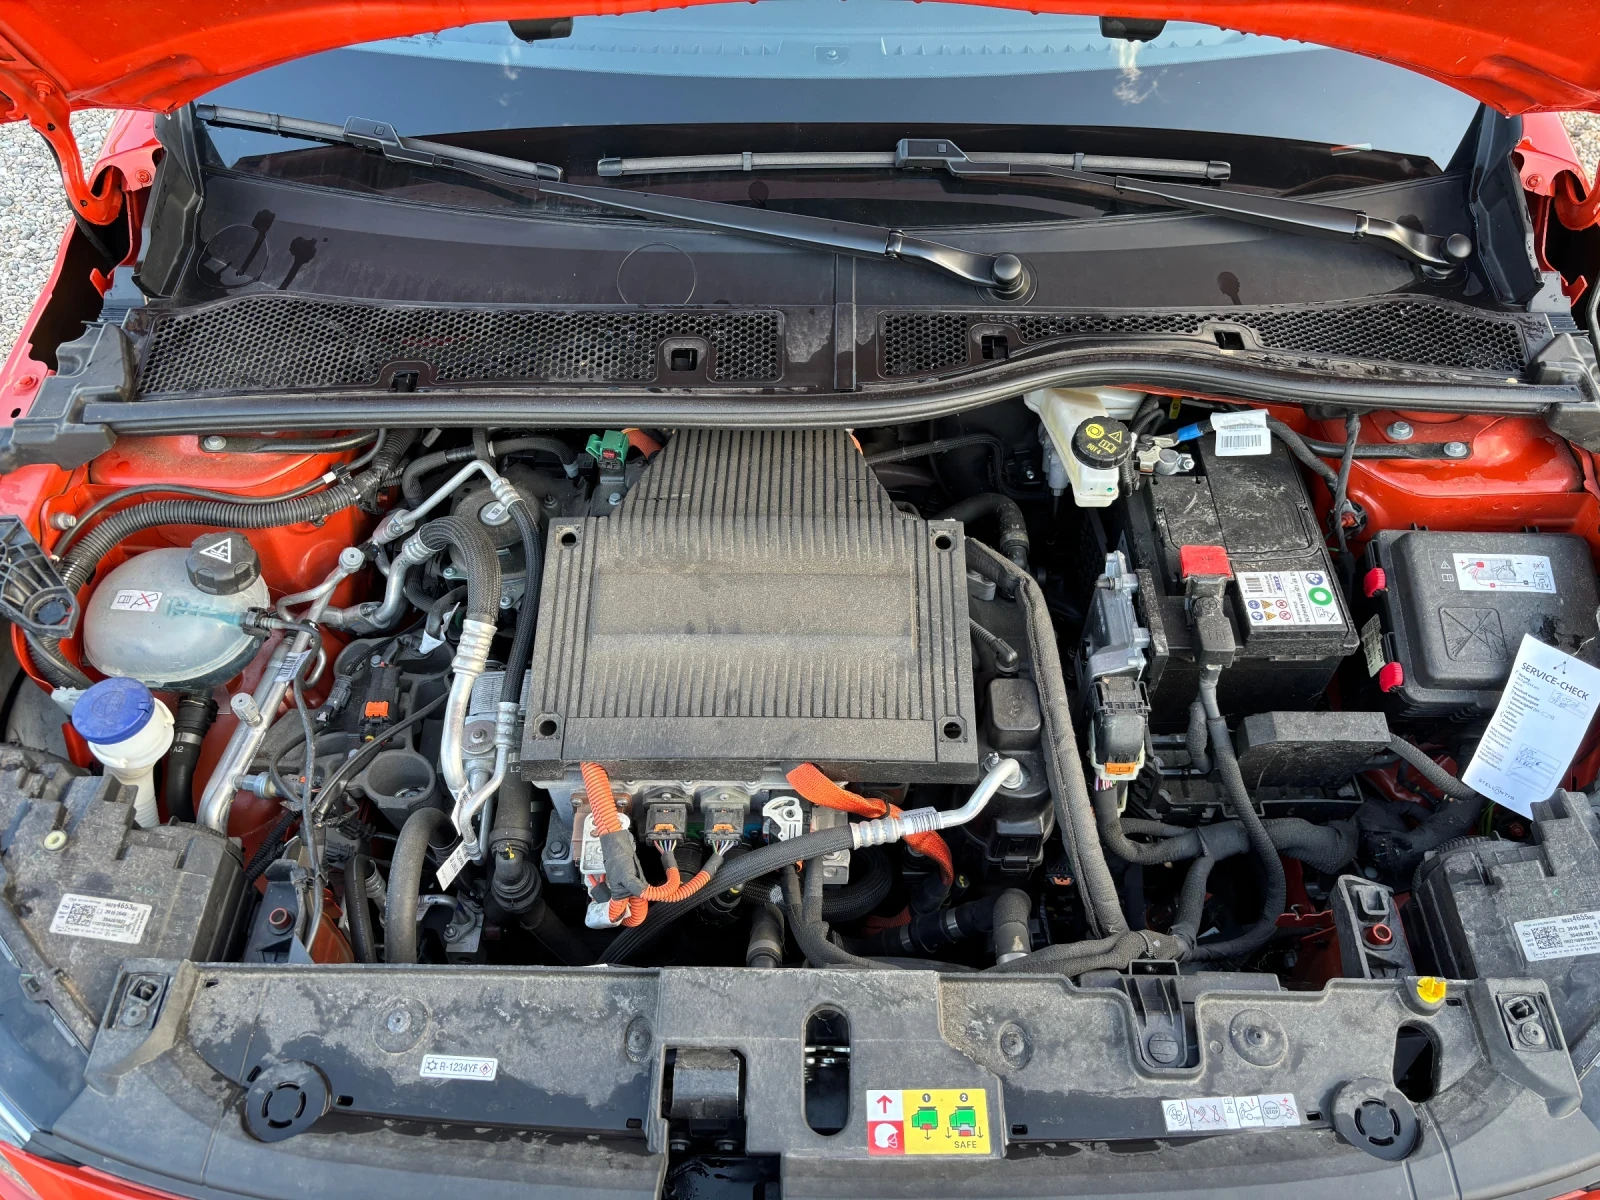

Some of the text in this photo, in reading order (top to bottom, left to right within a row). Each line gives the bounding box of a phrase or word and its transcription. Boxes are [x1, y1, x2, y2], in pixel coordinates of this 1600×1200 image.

[1521, 662, 1590, 701] SERVICE-CHECK
[510, 765, 521, 773] L2
[440, 1063, 478, 1073] R-1234YF
[954, 1141, 977, 1149] SAFE
